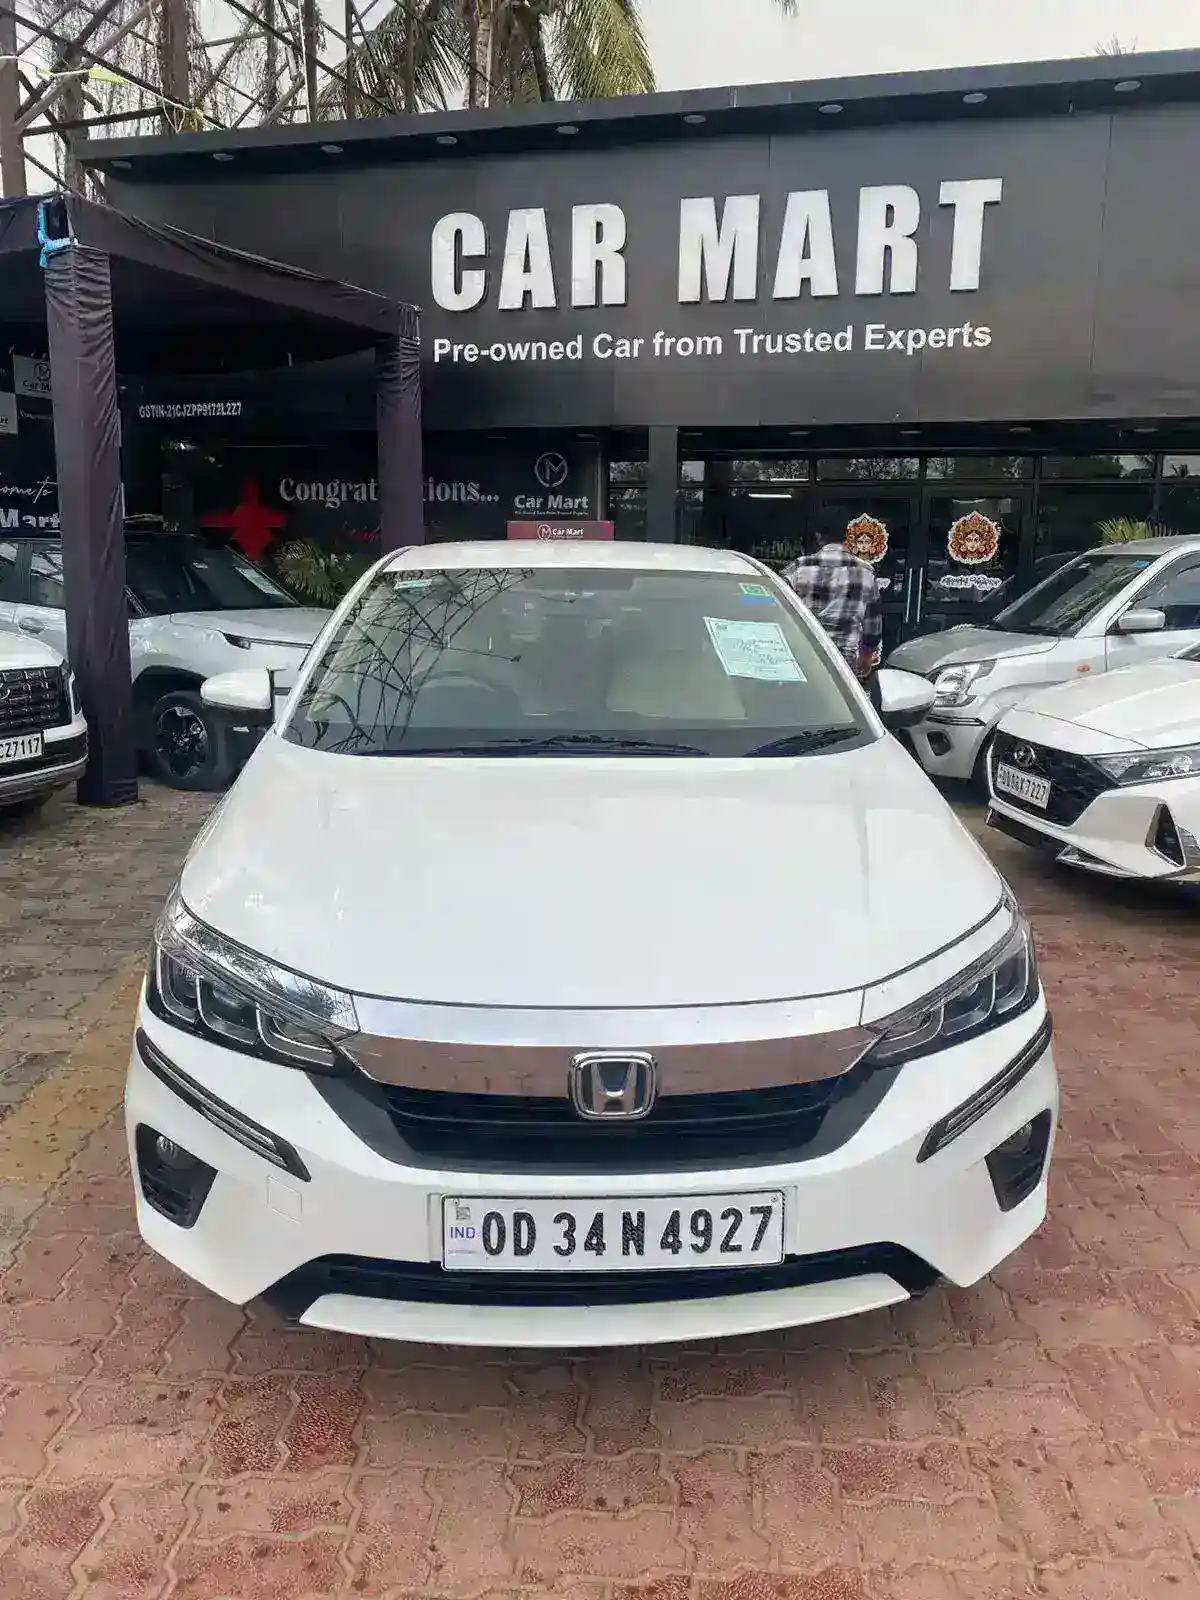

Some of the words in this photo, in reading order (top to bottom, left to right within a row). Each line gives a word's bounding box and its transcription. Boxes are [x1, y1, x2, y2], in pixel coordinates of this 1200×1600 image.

[430, 202, 628, 312] CAR
[678, 178, 1003, 303] MART
[433, 334, 583, 364] Pre-owned
[593, 332, 642, 360] Car
[652, 330, 723, 357] from
[734, 325, 853, 355] Trusted
[865, 321, 992, 355] Experts
[514, 495, 543, 509] Car
[547, 495, 589, 509] Mart
[450, 1226, 476, 1239] IND
[481, 1210, 537, 1257] OD
[552, 1211, 607, 1257] 34
[621, 1210, 646, 1256] N
[659, 1205, 773, 1255] 4927
